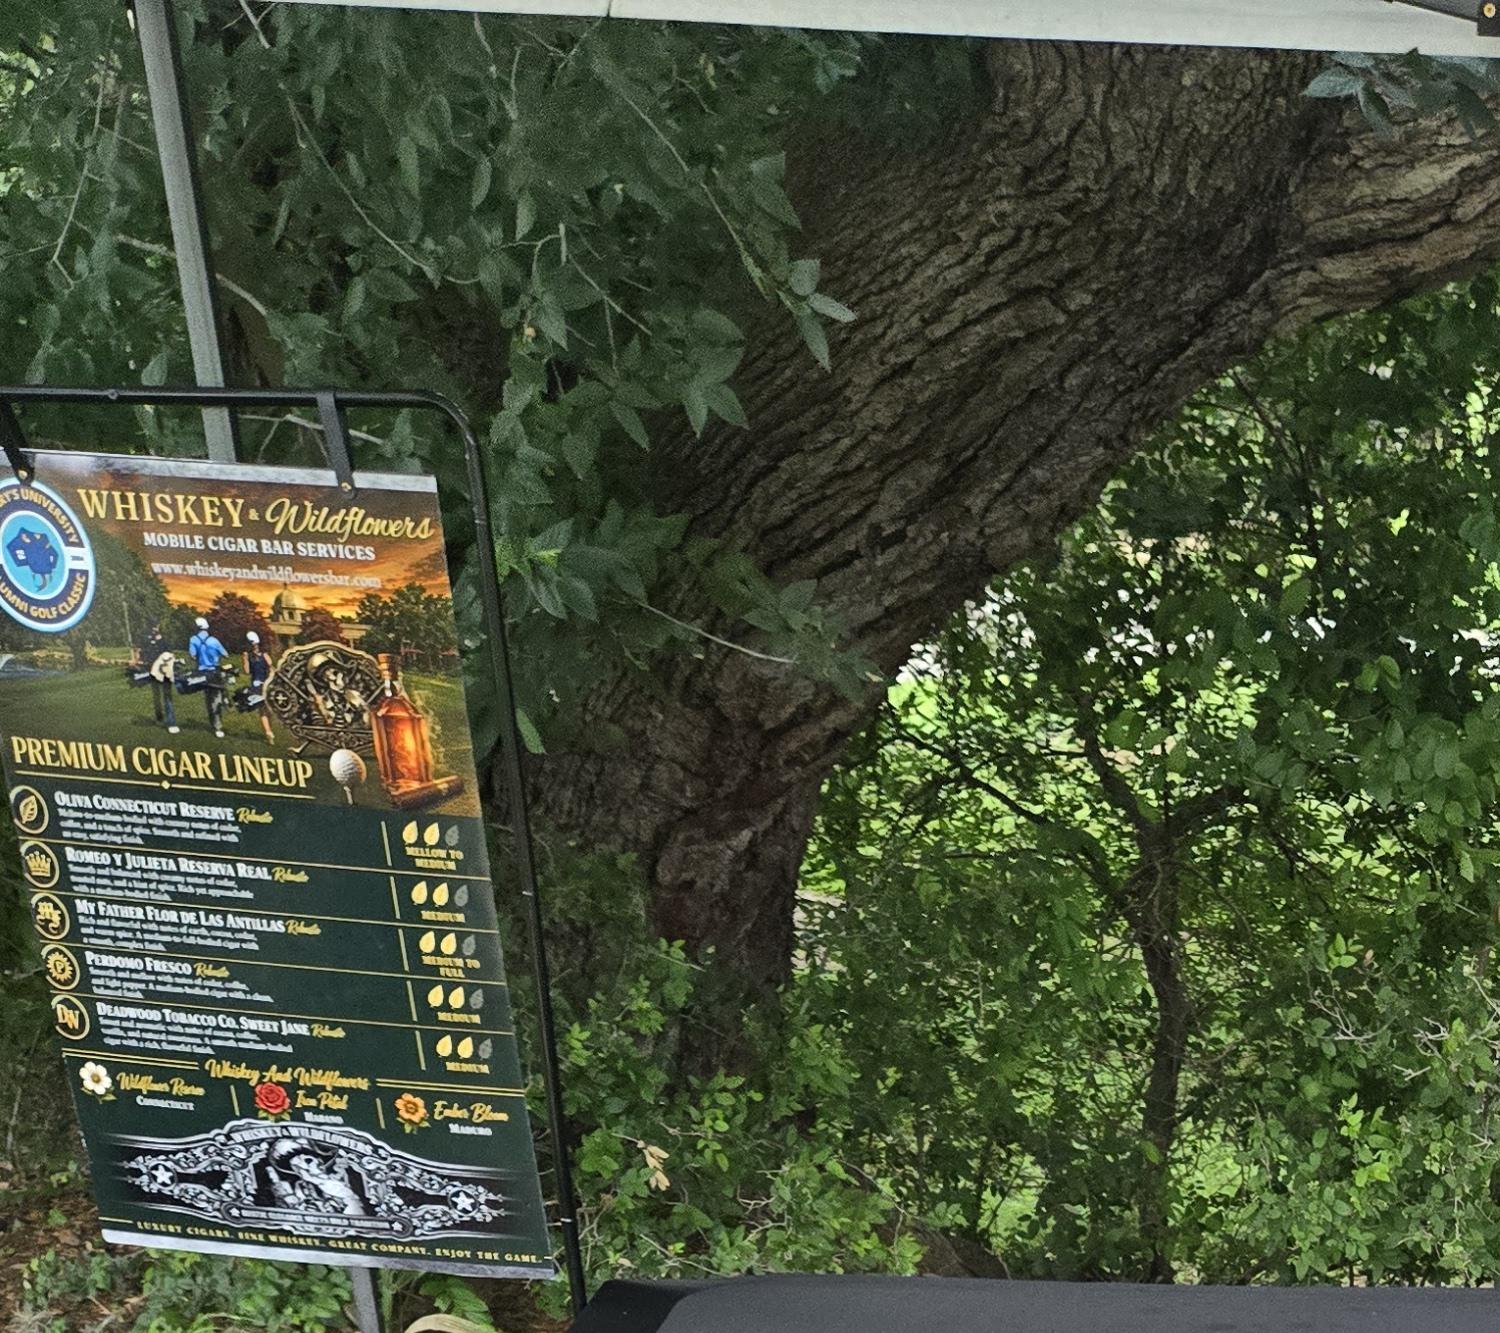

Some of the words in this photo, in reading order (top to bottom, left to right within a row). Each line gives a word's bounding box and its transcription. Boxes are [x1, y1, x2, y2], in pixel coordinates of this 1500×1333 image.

[20, 488, 80, 544] UNIVERSITY
[77, 489, 245, 528] WHISKEY
[249, 508, 260, 521] &
[265, 498, 434, 542] Wildflowers
[144, 532, 203, 551] MOBILE
[207, 536, 258, 554] CIGAR
[262, 539, 294, 557] BAR
[298, 542, 375, 561] SERVICES
[29, 606, 58, 619] GOLF
[58, 573, 86, 615] CLASSIC
[11, 736, 127, 772] PREMIUM
[132, 746, 215, 780] CIGAR
[218, 754, 313, 788] LINEUP
[54, 791, 92, 809] OLIVA
[93, 794, 178, 816] CONNECTICUT
[179, 801, 235, 821] RESERVE
[65, 847, 111, 865] ROMEO
[113, 852, 123, 866] Y
[125, 853, 177, 872] JULIETA
[178, 857, 235, 877] RESERVA
[236, 863, 272, 880] REAL
[74, 899, 97, 915] MY
[98, 900, 144, 920] FATHER
[146, 906, 179, 922] FLOR
[180, 910, 198, 925] DE
[199, 911, 224, 927] LAS
[85, 950, 144, 972] PERDOMO
[145, 957, 192, 976] FRESCO
[95, 1001, 161, 1022] DEADWOOD
[161, 1008, 217, 1029] TOBACCO
[204, 1059, 260, 1086] Whiskey
[261, 1065, 292, 1083] And
[293, 1067, 370, 1091] Wildflowers
[328, 1240, 367, 1251] GREAT
[435, 1248, 471, 1259] ENJOY
